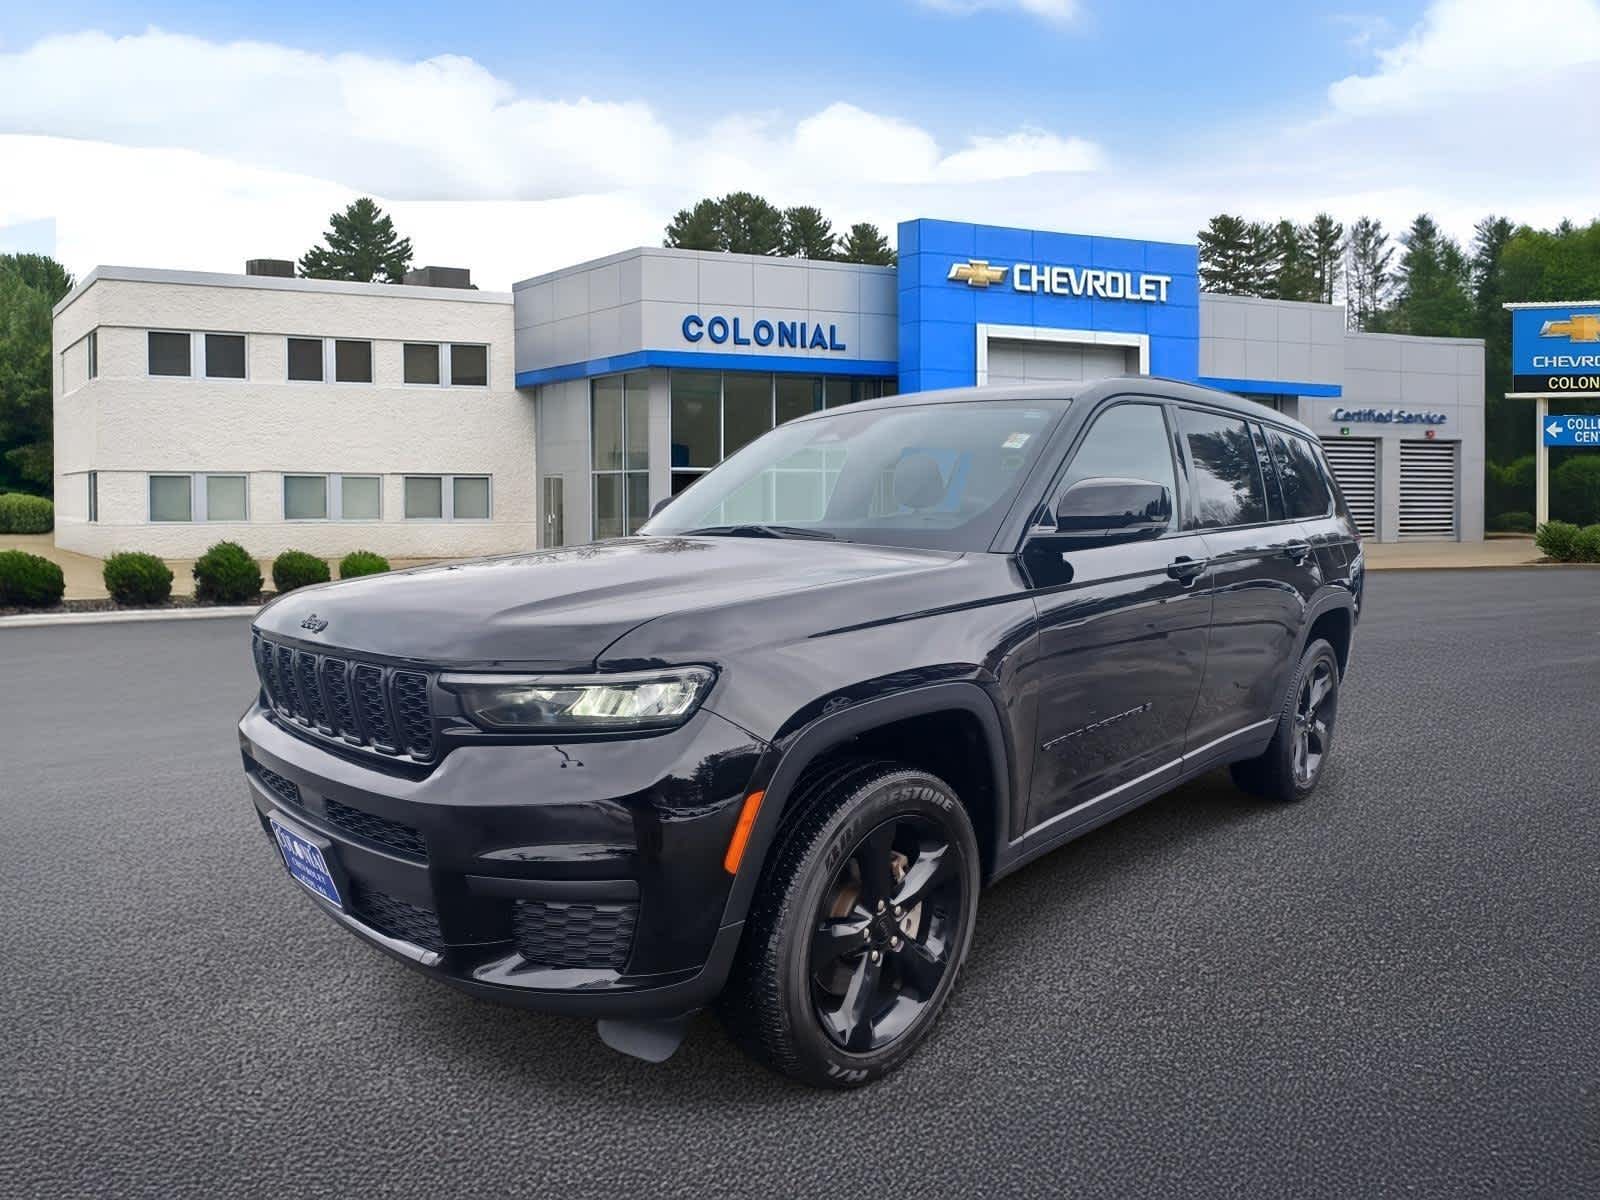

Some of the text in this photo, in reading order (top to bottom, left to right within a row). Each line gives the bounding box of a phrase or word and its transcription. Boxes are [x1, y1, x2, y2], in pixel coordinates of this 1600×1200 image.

[1013, 263, 1172, 303] CHEVROLET
[682, 314, 846, 351] COLONIAL
[1333, 408, 1447, 424] Certified Service
